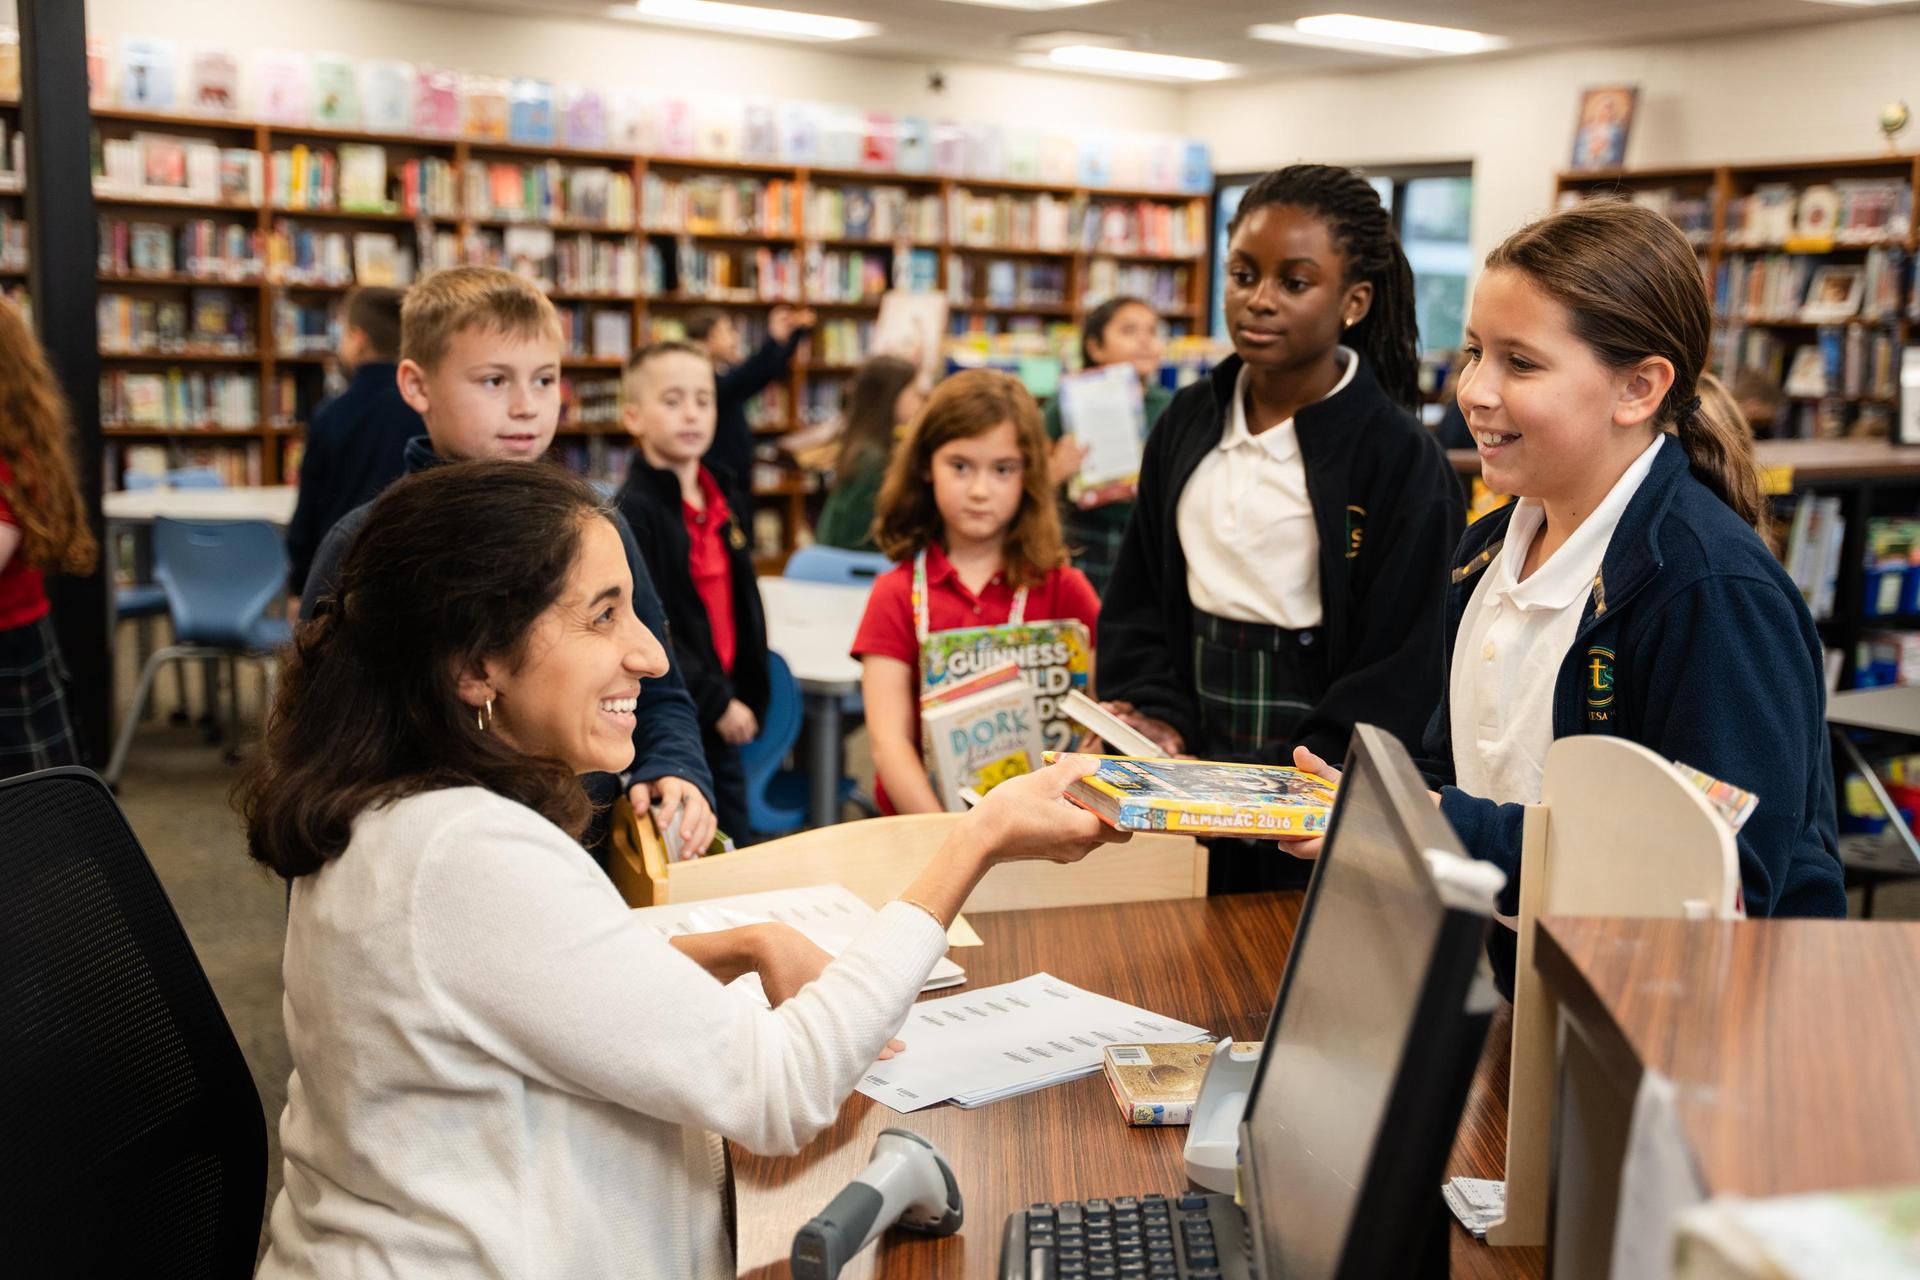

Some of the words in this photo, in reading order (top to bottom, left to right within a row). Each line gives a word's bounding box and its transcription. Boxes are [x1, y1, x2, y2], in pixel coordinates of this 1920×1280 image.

[948, 641, 1069, 676] GUINNESS
[950, 707, 1030, 756] DORK
[1179, 812, 1253, 828] ALMANAC
[1256, 814, 1291, 829] 2016
